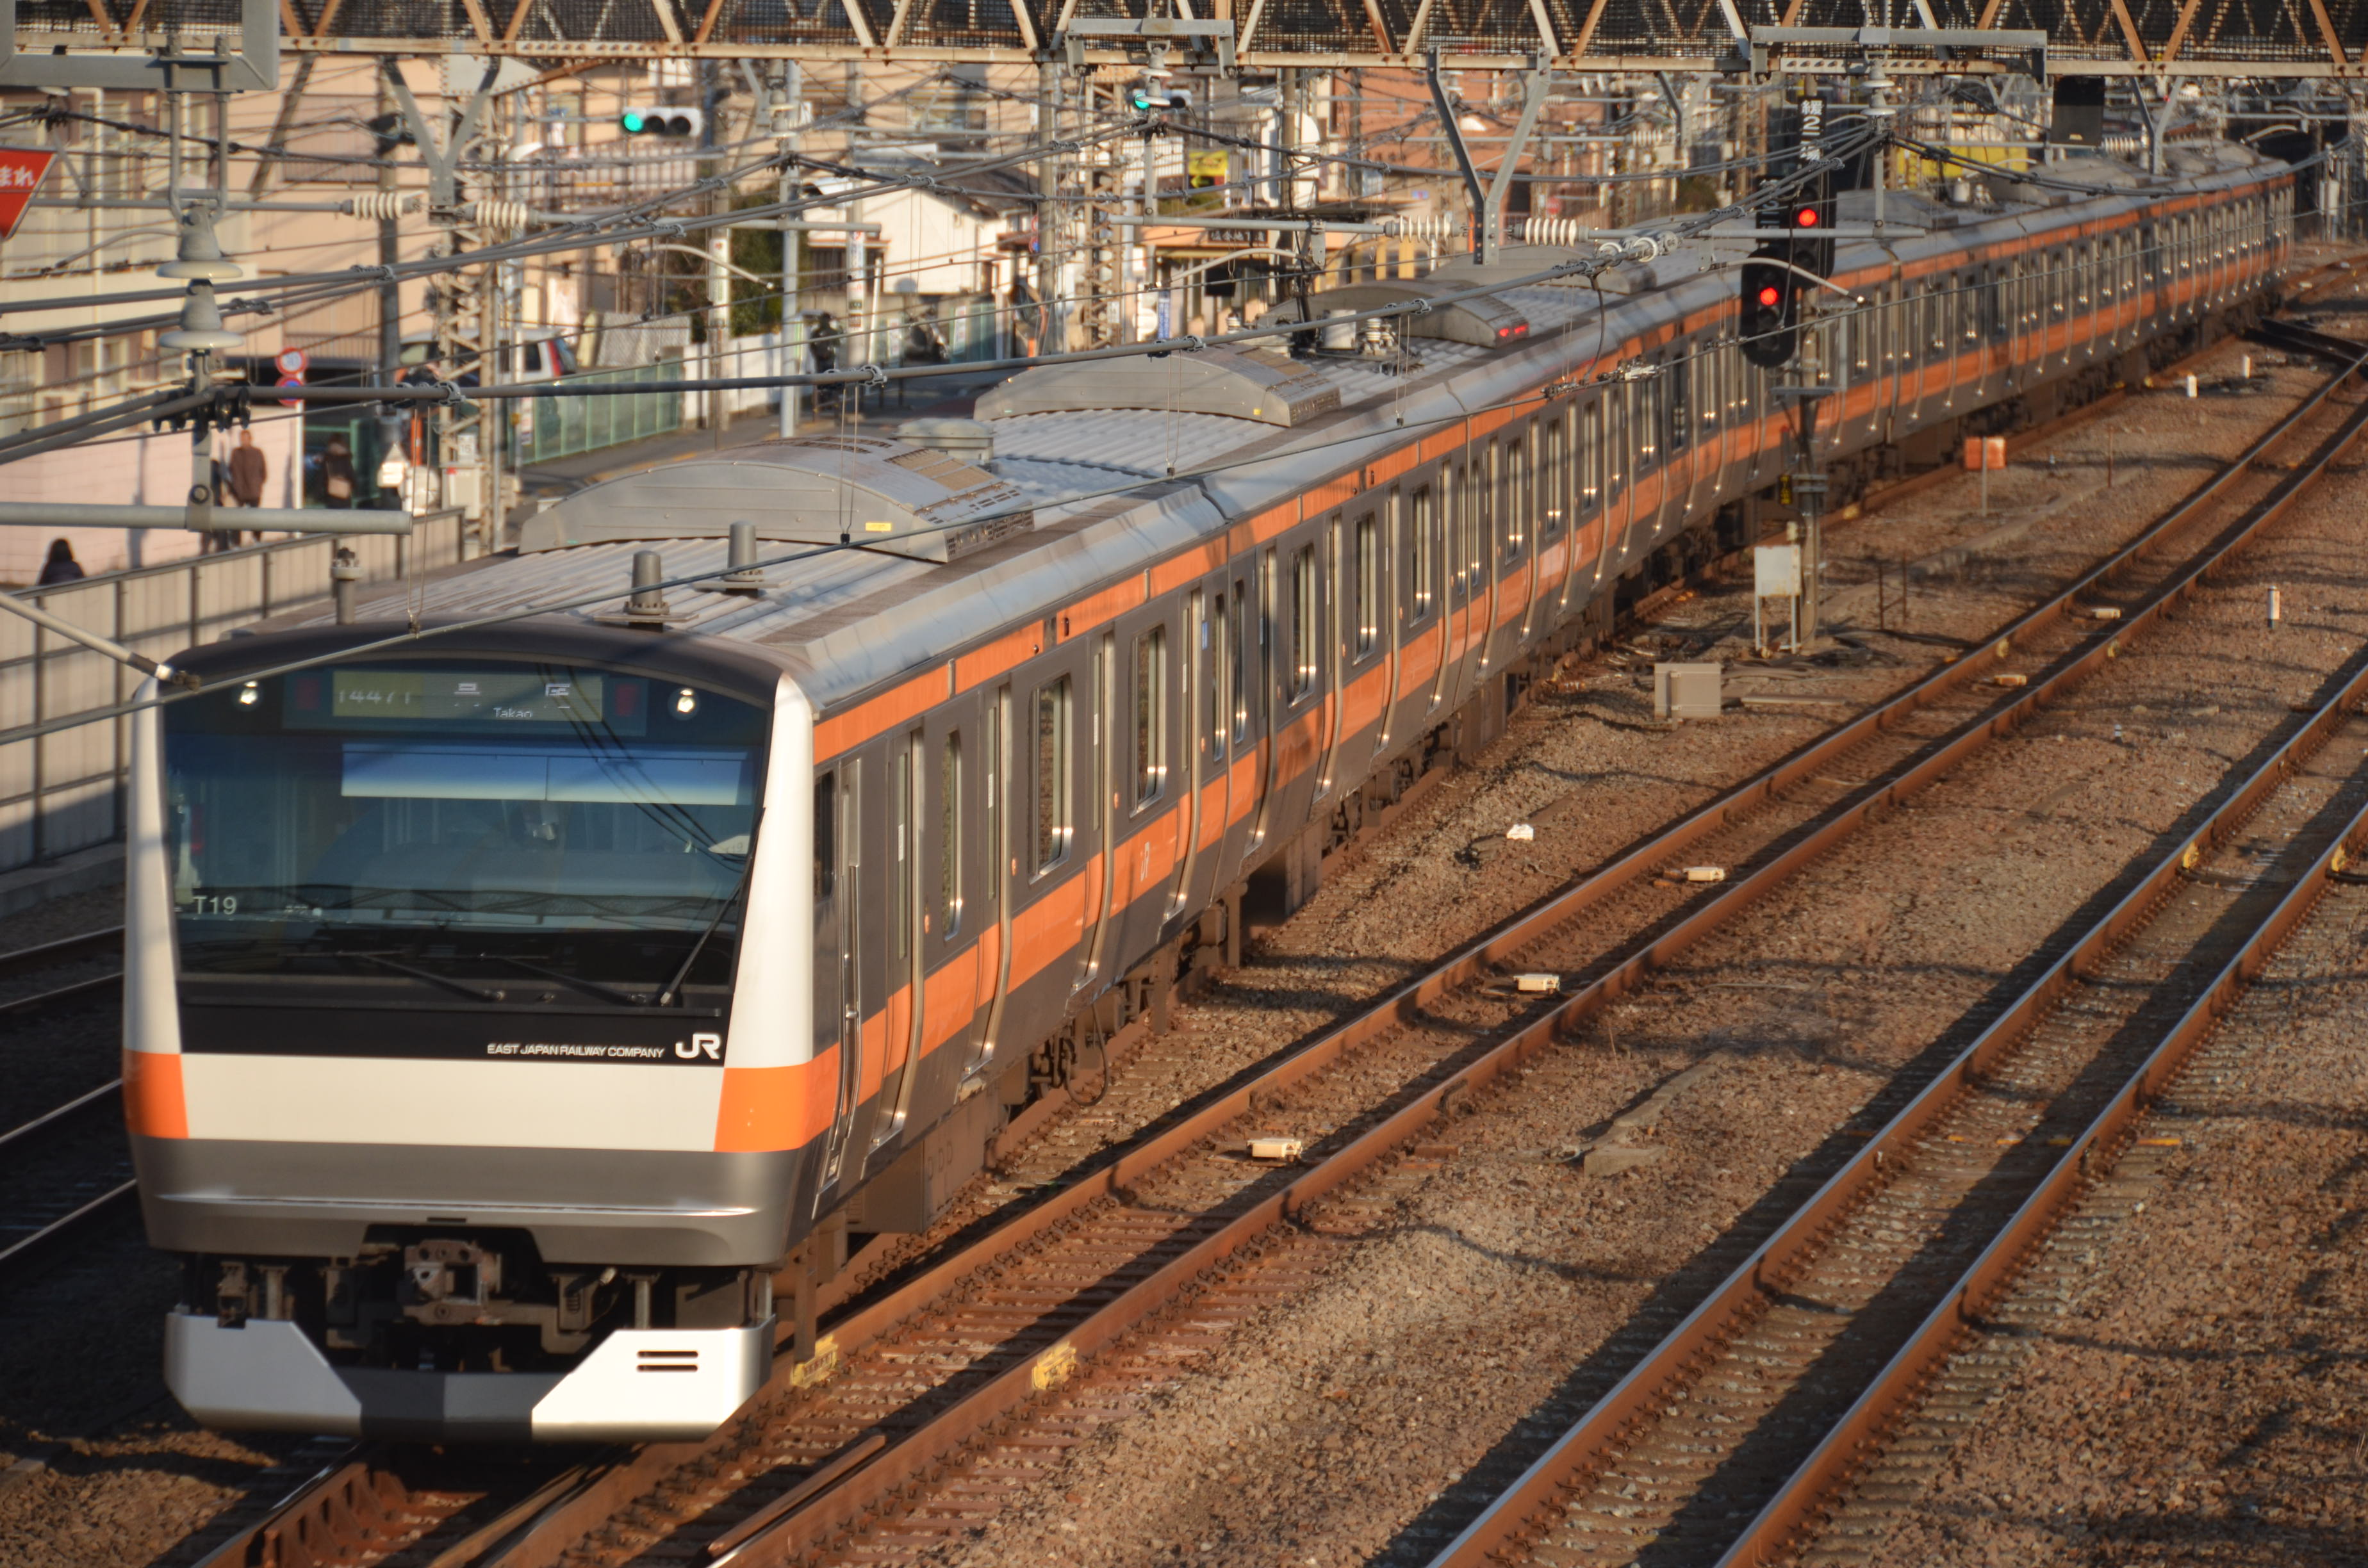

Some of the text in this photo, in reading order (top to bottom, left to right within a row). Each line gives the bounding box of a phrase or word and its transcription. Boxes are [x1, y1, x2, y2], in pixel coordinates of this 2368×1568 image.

[193, 896, 237, 915] T19
[487, 1043, 666, 1058] EAST JAPAN RAILWAY COMPANY
[675, 1033, 721, 1060] JR
